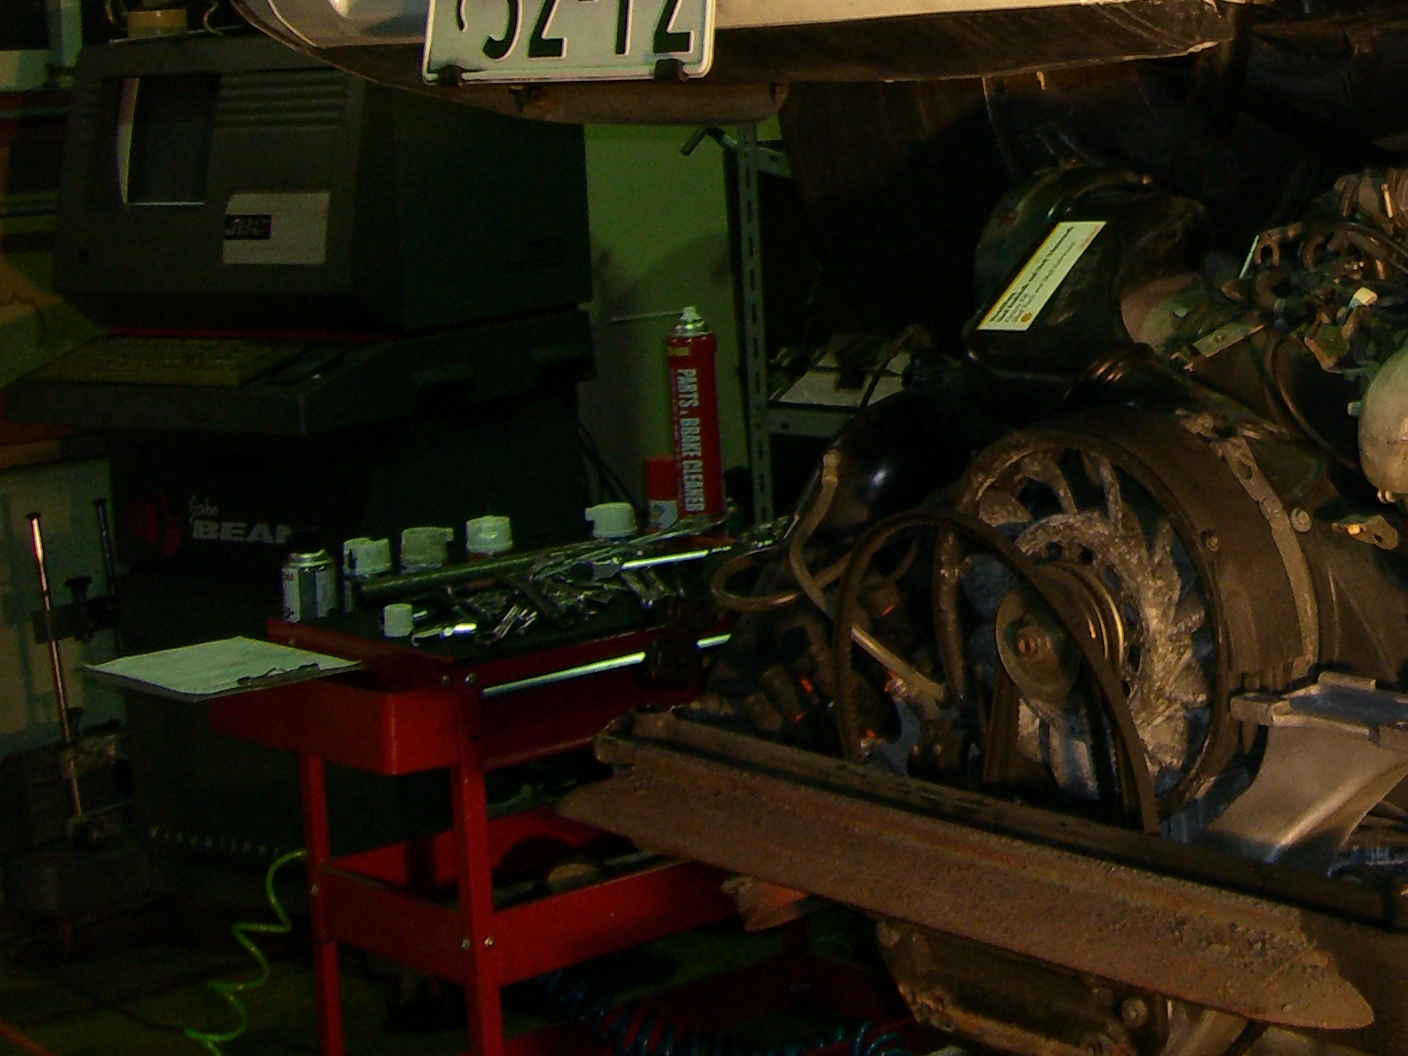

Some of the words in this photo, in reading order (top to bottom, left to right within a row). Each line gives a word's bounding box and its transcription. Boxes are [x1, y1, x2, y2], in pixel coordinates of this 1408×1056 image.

[677, 368, 699, 409] PARTS
[679, 417, 702, 458] BRAKE
[682, 459, 706, 512] CLEANER
